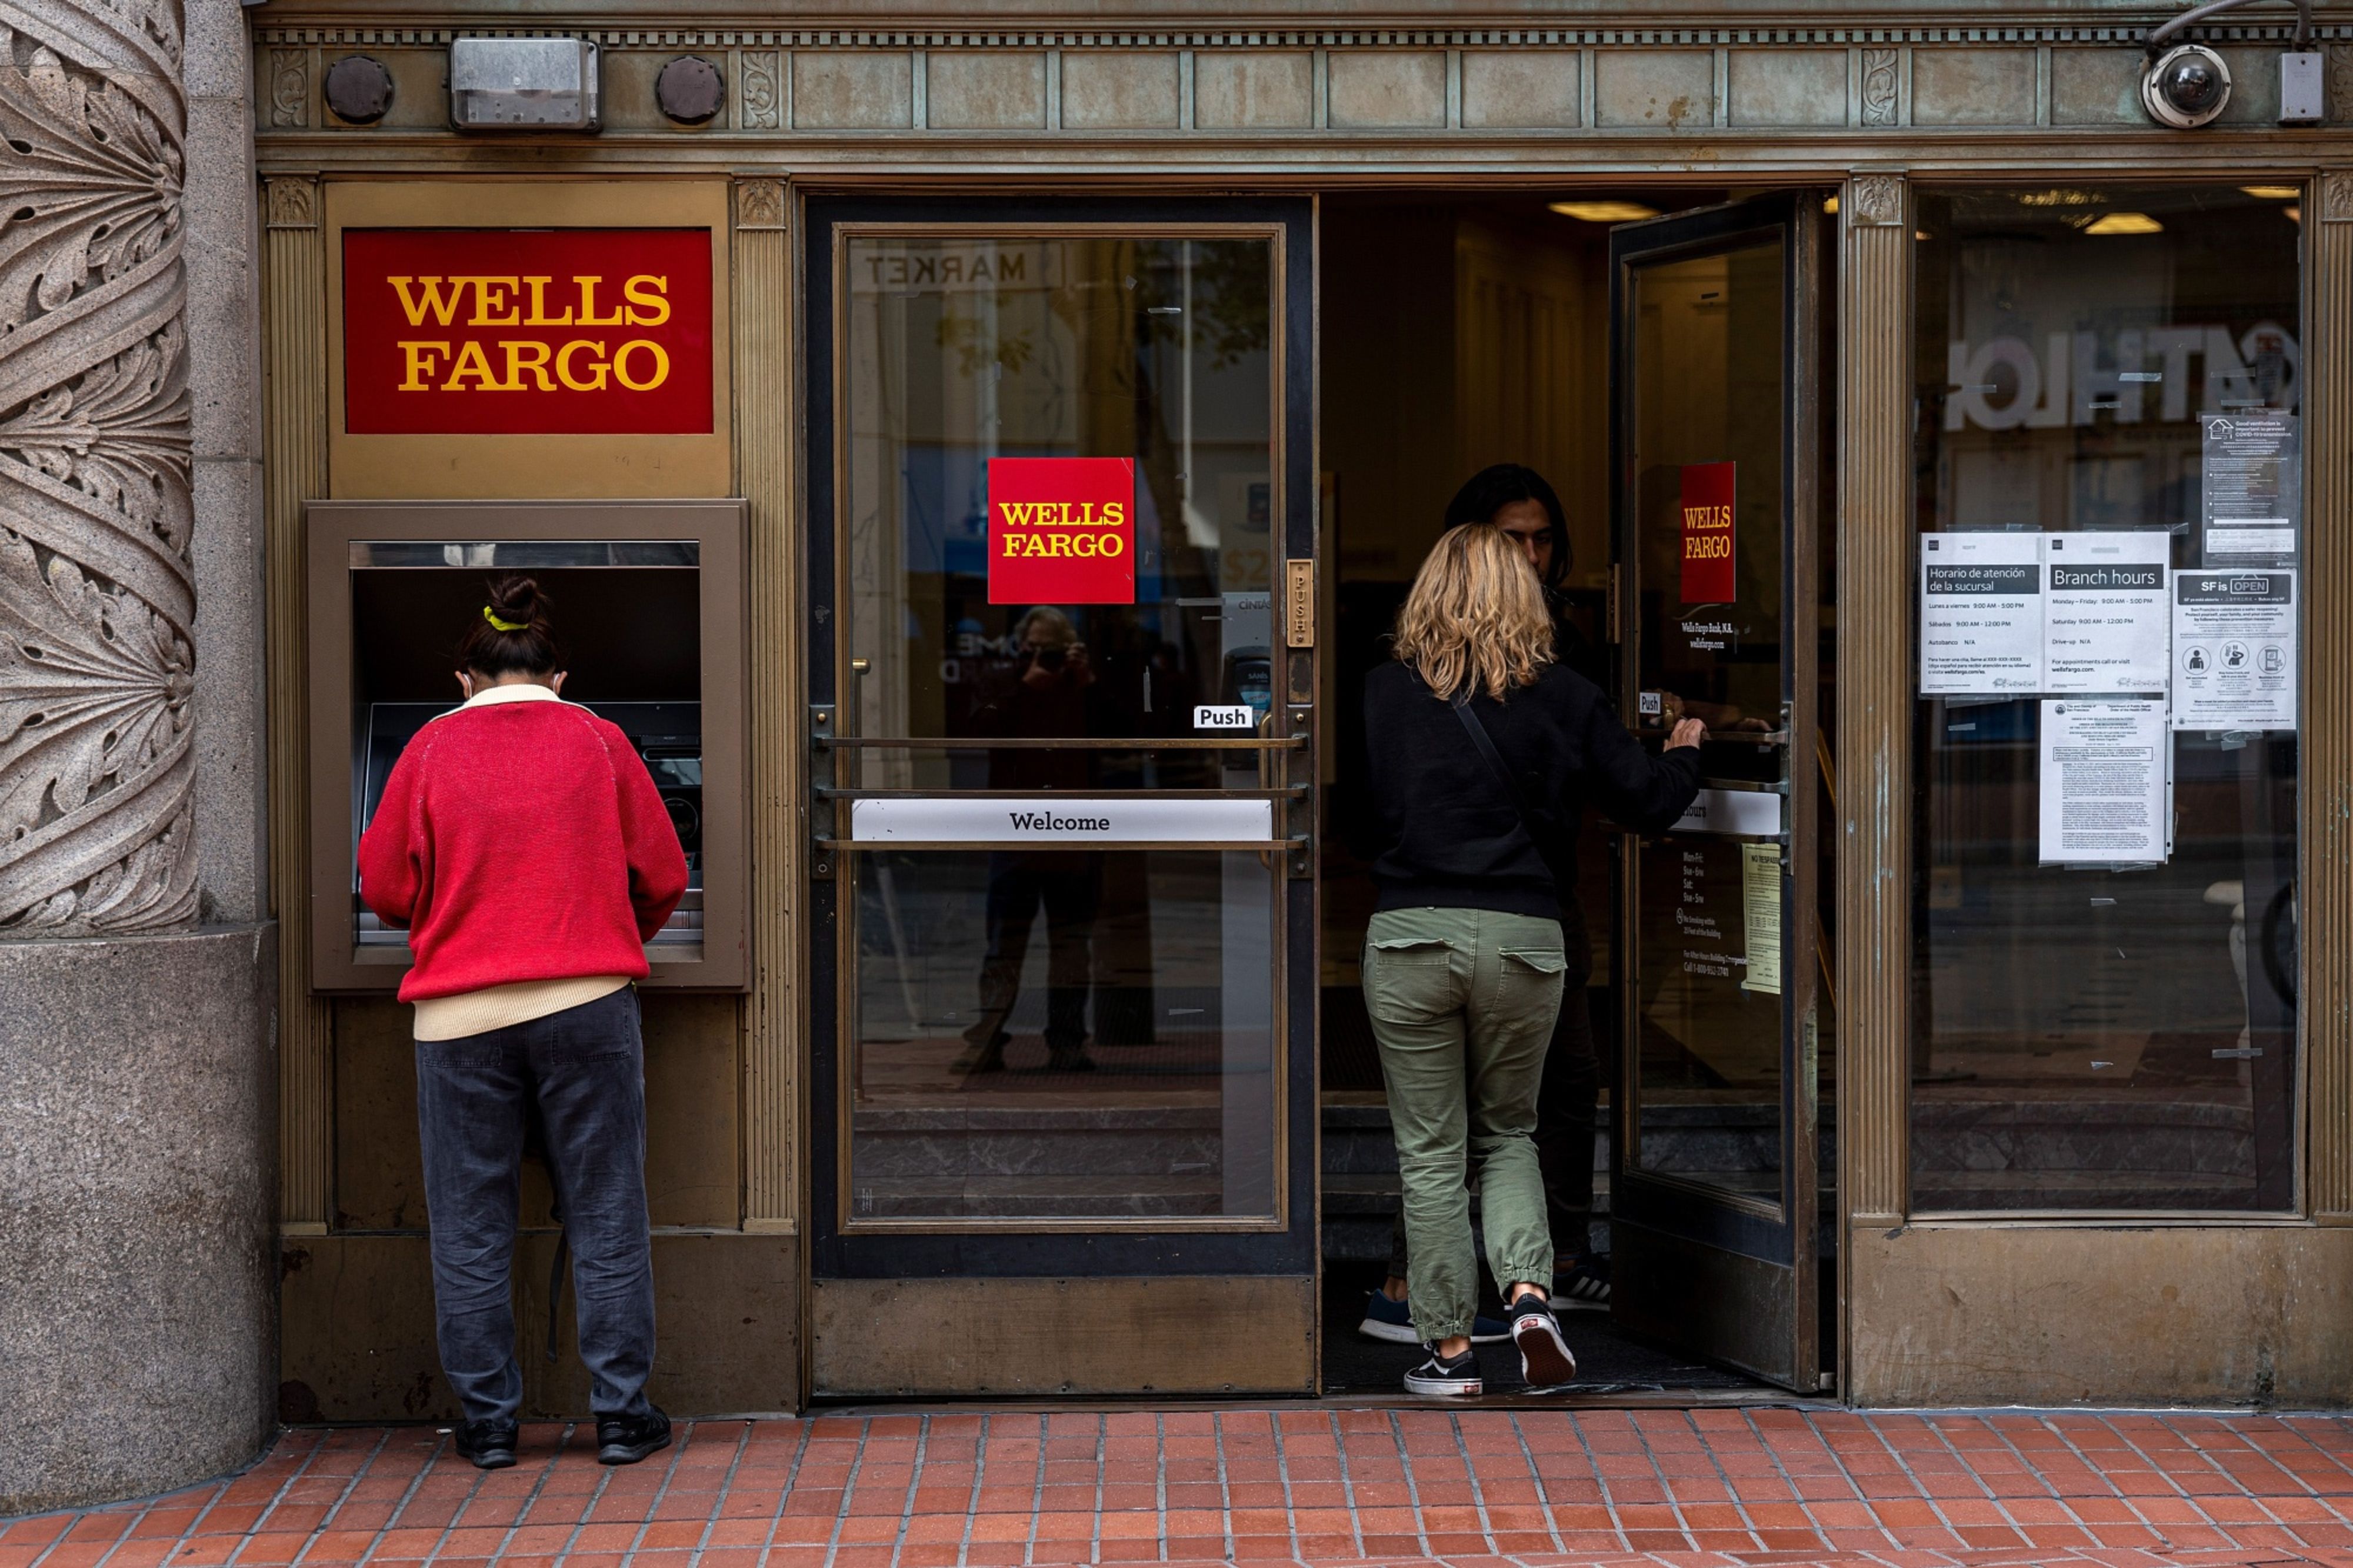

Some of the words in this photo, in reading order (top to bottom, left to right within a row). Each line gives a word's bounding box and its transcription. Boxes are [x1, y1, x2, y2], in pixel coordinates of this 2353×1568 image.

[387, 275, 671, 326] WELLS
[398, 340, 670, 391] FARGO
[999, 502, 1124, 527] WELLS
[1684, 505, 1730, 529] WELLS
[1002, 534, 1124, 558] FARGO
[1685, 535, 1730, 559] FARGO
[1930, 568, 1966, 578] Horario
[1969, 568, 1981, 578] de
[1984, 568, 2025, 578] atención
[2055, 569, 2107, 585] Branch
[2112, 569, 2155, 585] hours
[1930, 581, 1942, 591] de
[1945, 581, 1952, 591] la
[1955, 581, 1994, 591] sucursal
[2201, 582, 2216, 591] SF
[2218, 582, 2228, 591] is
[2234, 582, 2265, 591] OPEN
[1294, 576, 1307, 632] PUSH
[1682, 622, 1695, 632] Wells
[1695, 623, 1709, 635] Fargo
[1642, 696, 1658, 711] Push
[1199, 709, 1246, 726] Push
[1010, 812, 1110, 832] Welcome
